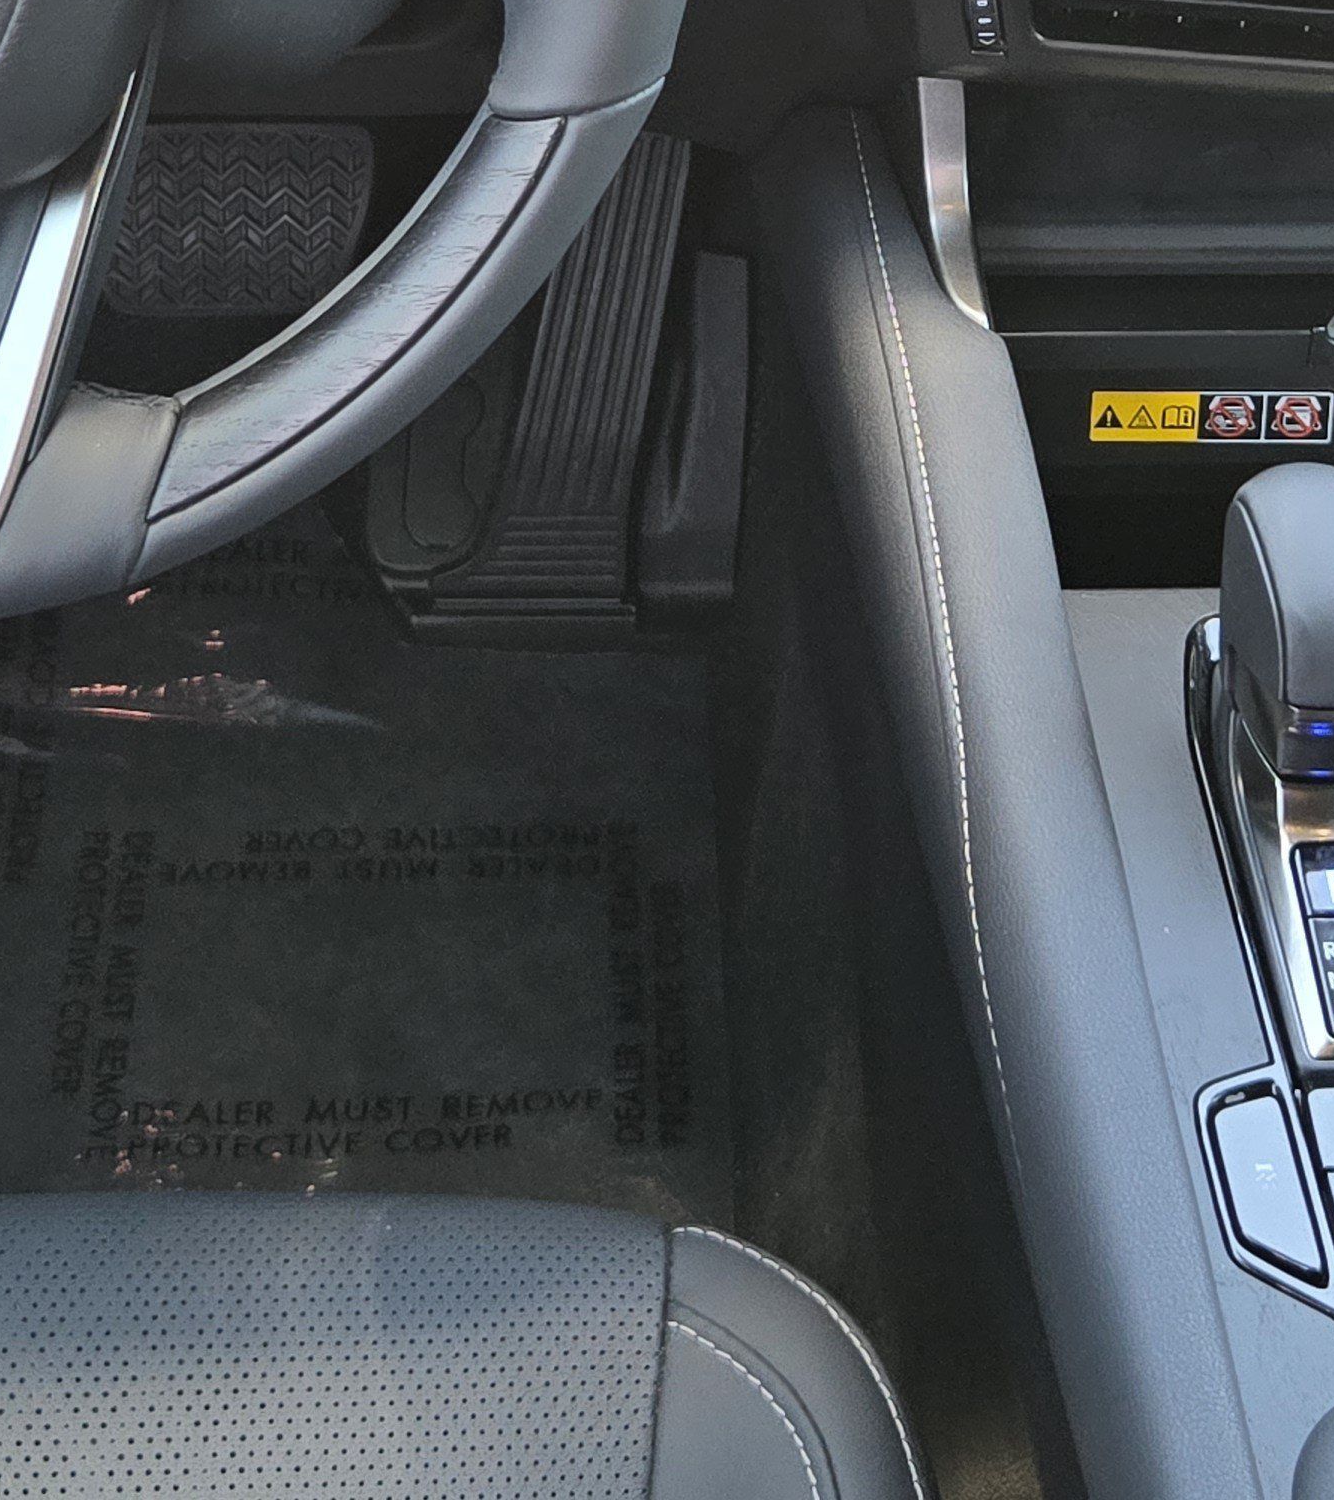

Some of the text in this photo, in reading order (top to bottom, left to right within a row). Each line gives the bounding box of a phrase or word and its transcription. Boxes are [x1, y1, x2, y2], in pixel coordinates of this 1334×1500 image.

[304, 1096, 414, 1124] MUST
[442, 1088, 603, 1120] REMOVE
[384, 1123, 512, 1154] COVER
